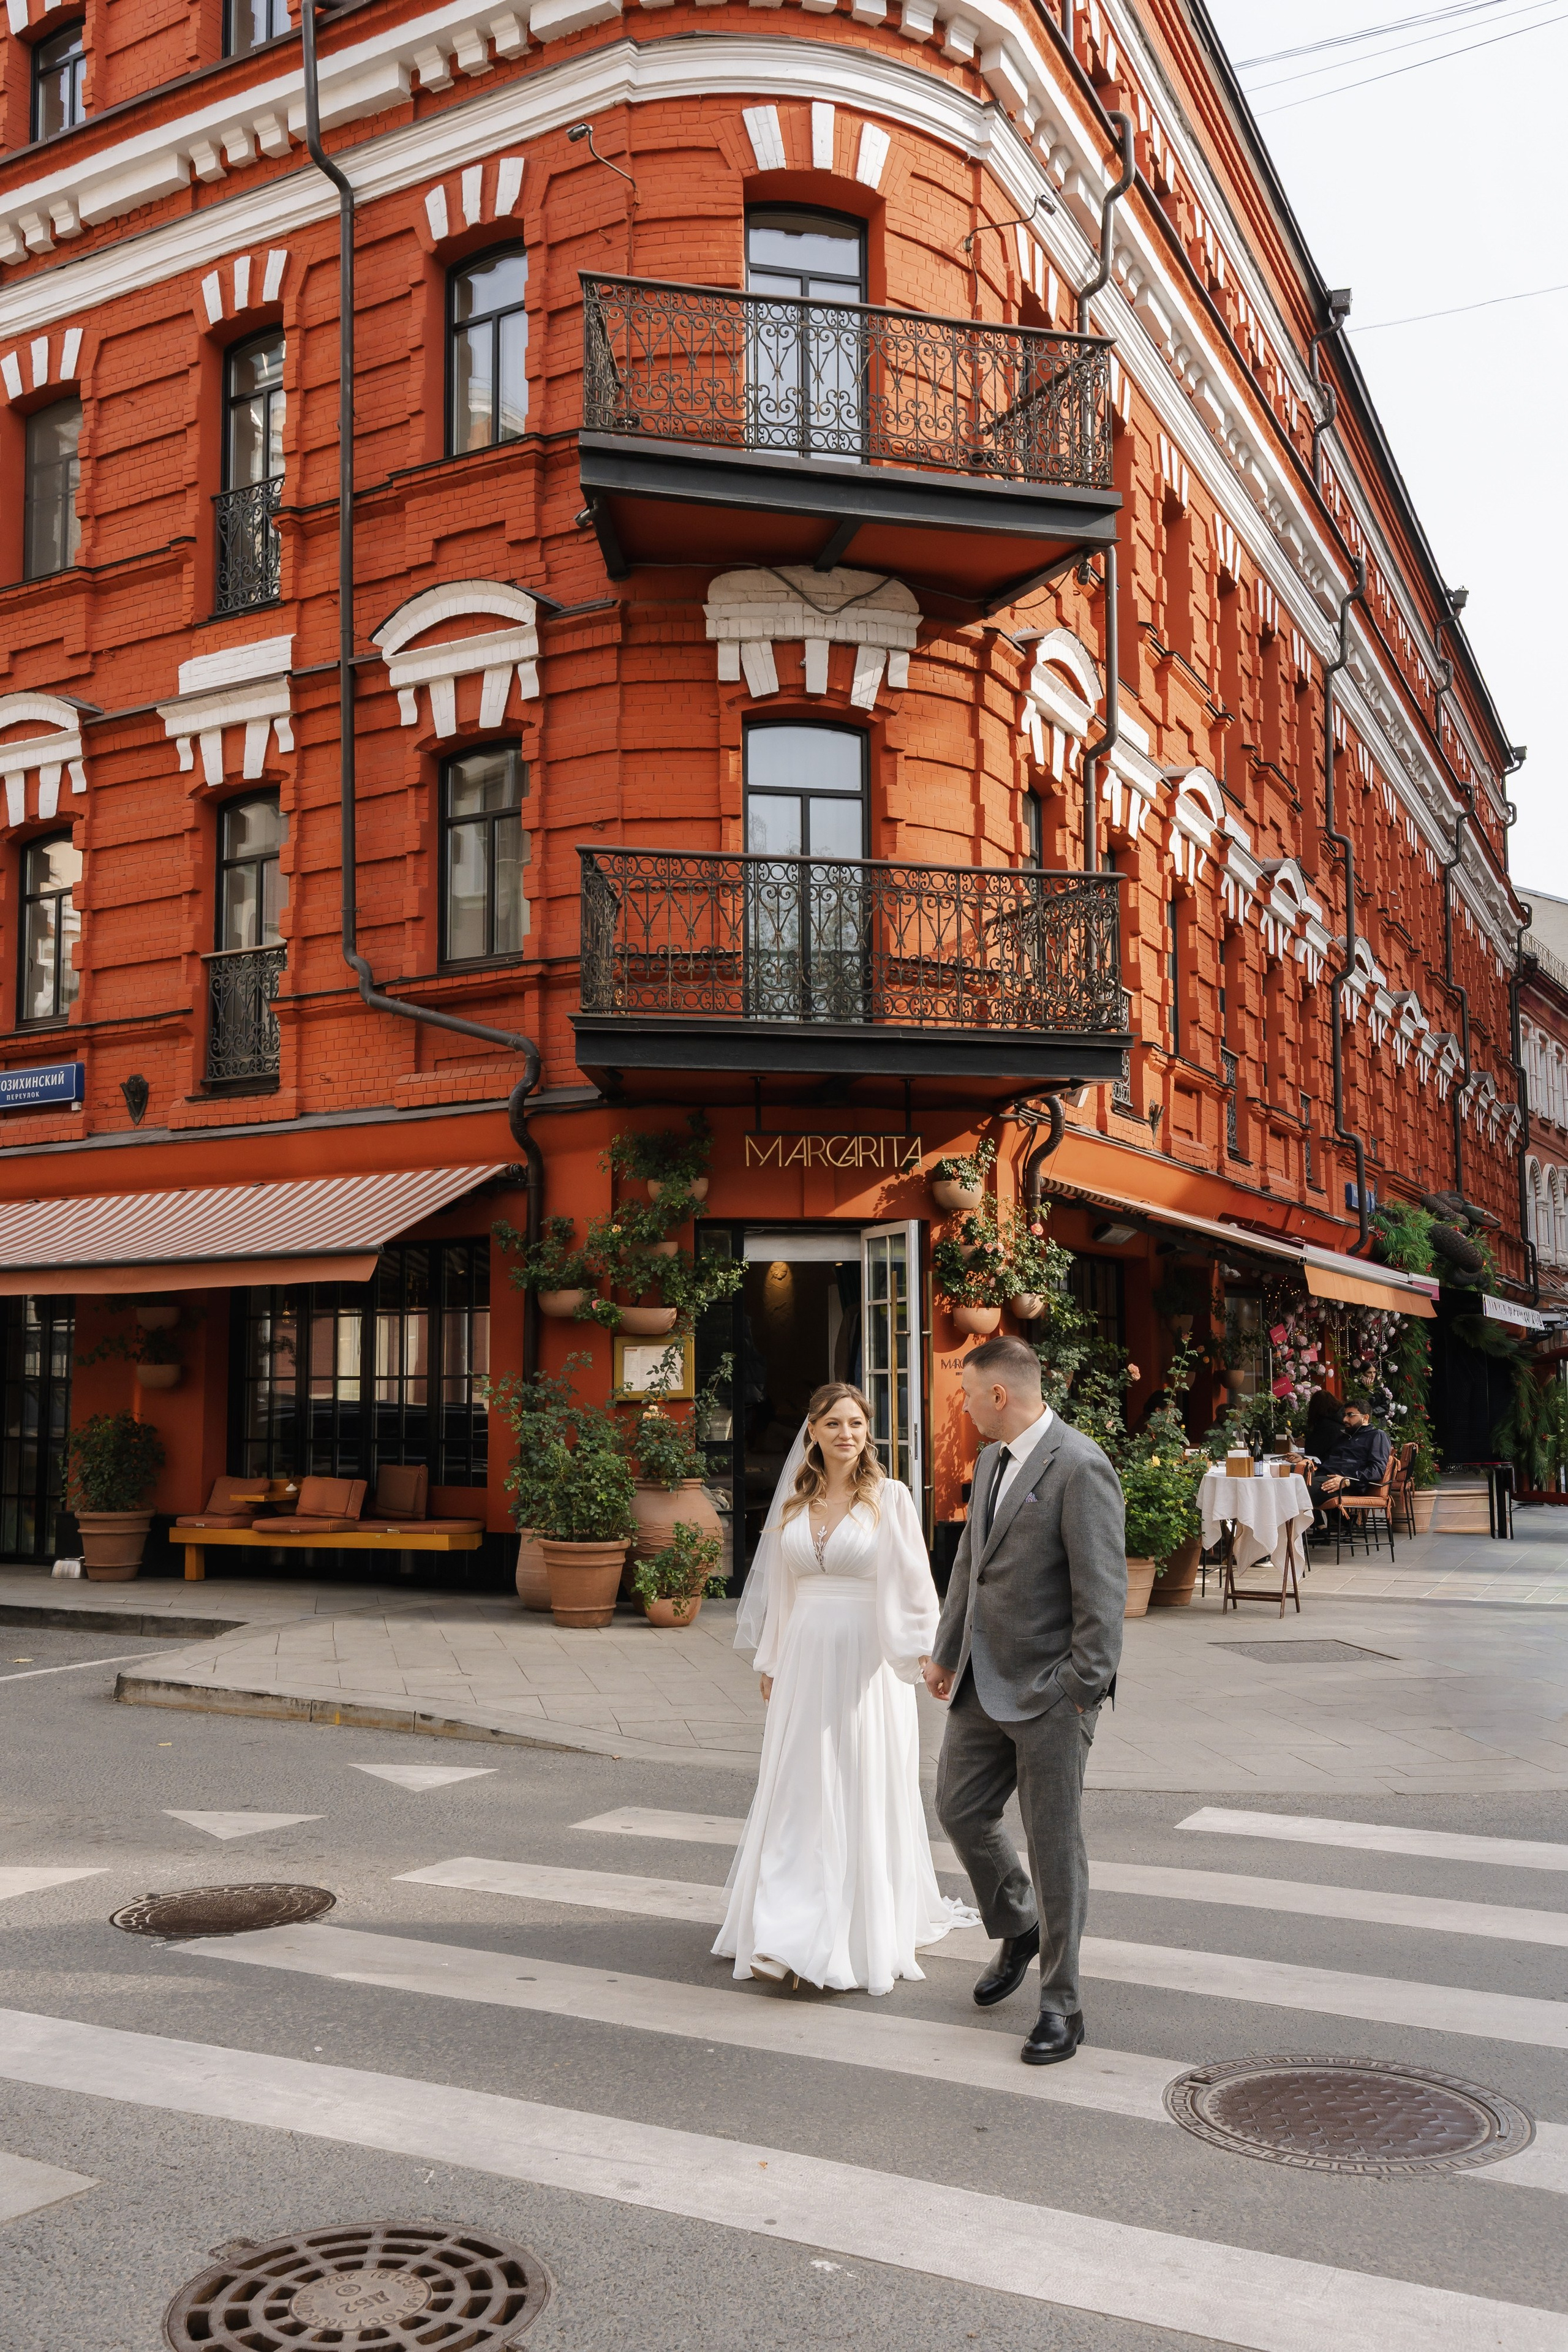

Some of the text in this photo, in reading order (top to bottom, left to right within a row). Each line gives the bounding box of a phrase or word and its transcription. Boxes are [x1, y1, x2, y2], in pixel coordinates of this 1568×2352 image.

[0, 1071, 64, 1091] ОЗИХИНСКИЙ
[6, 1091, 40, 1101] ПЕРЕУЛОК
[745, 1135, 922, 1168] MARGARITA
